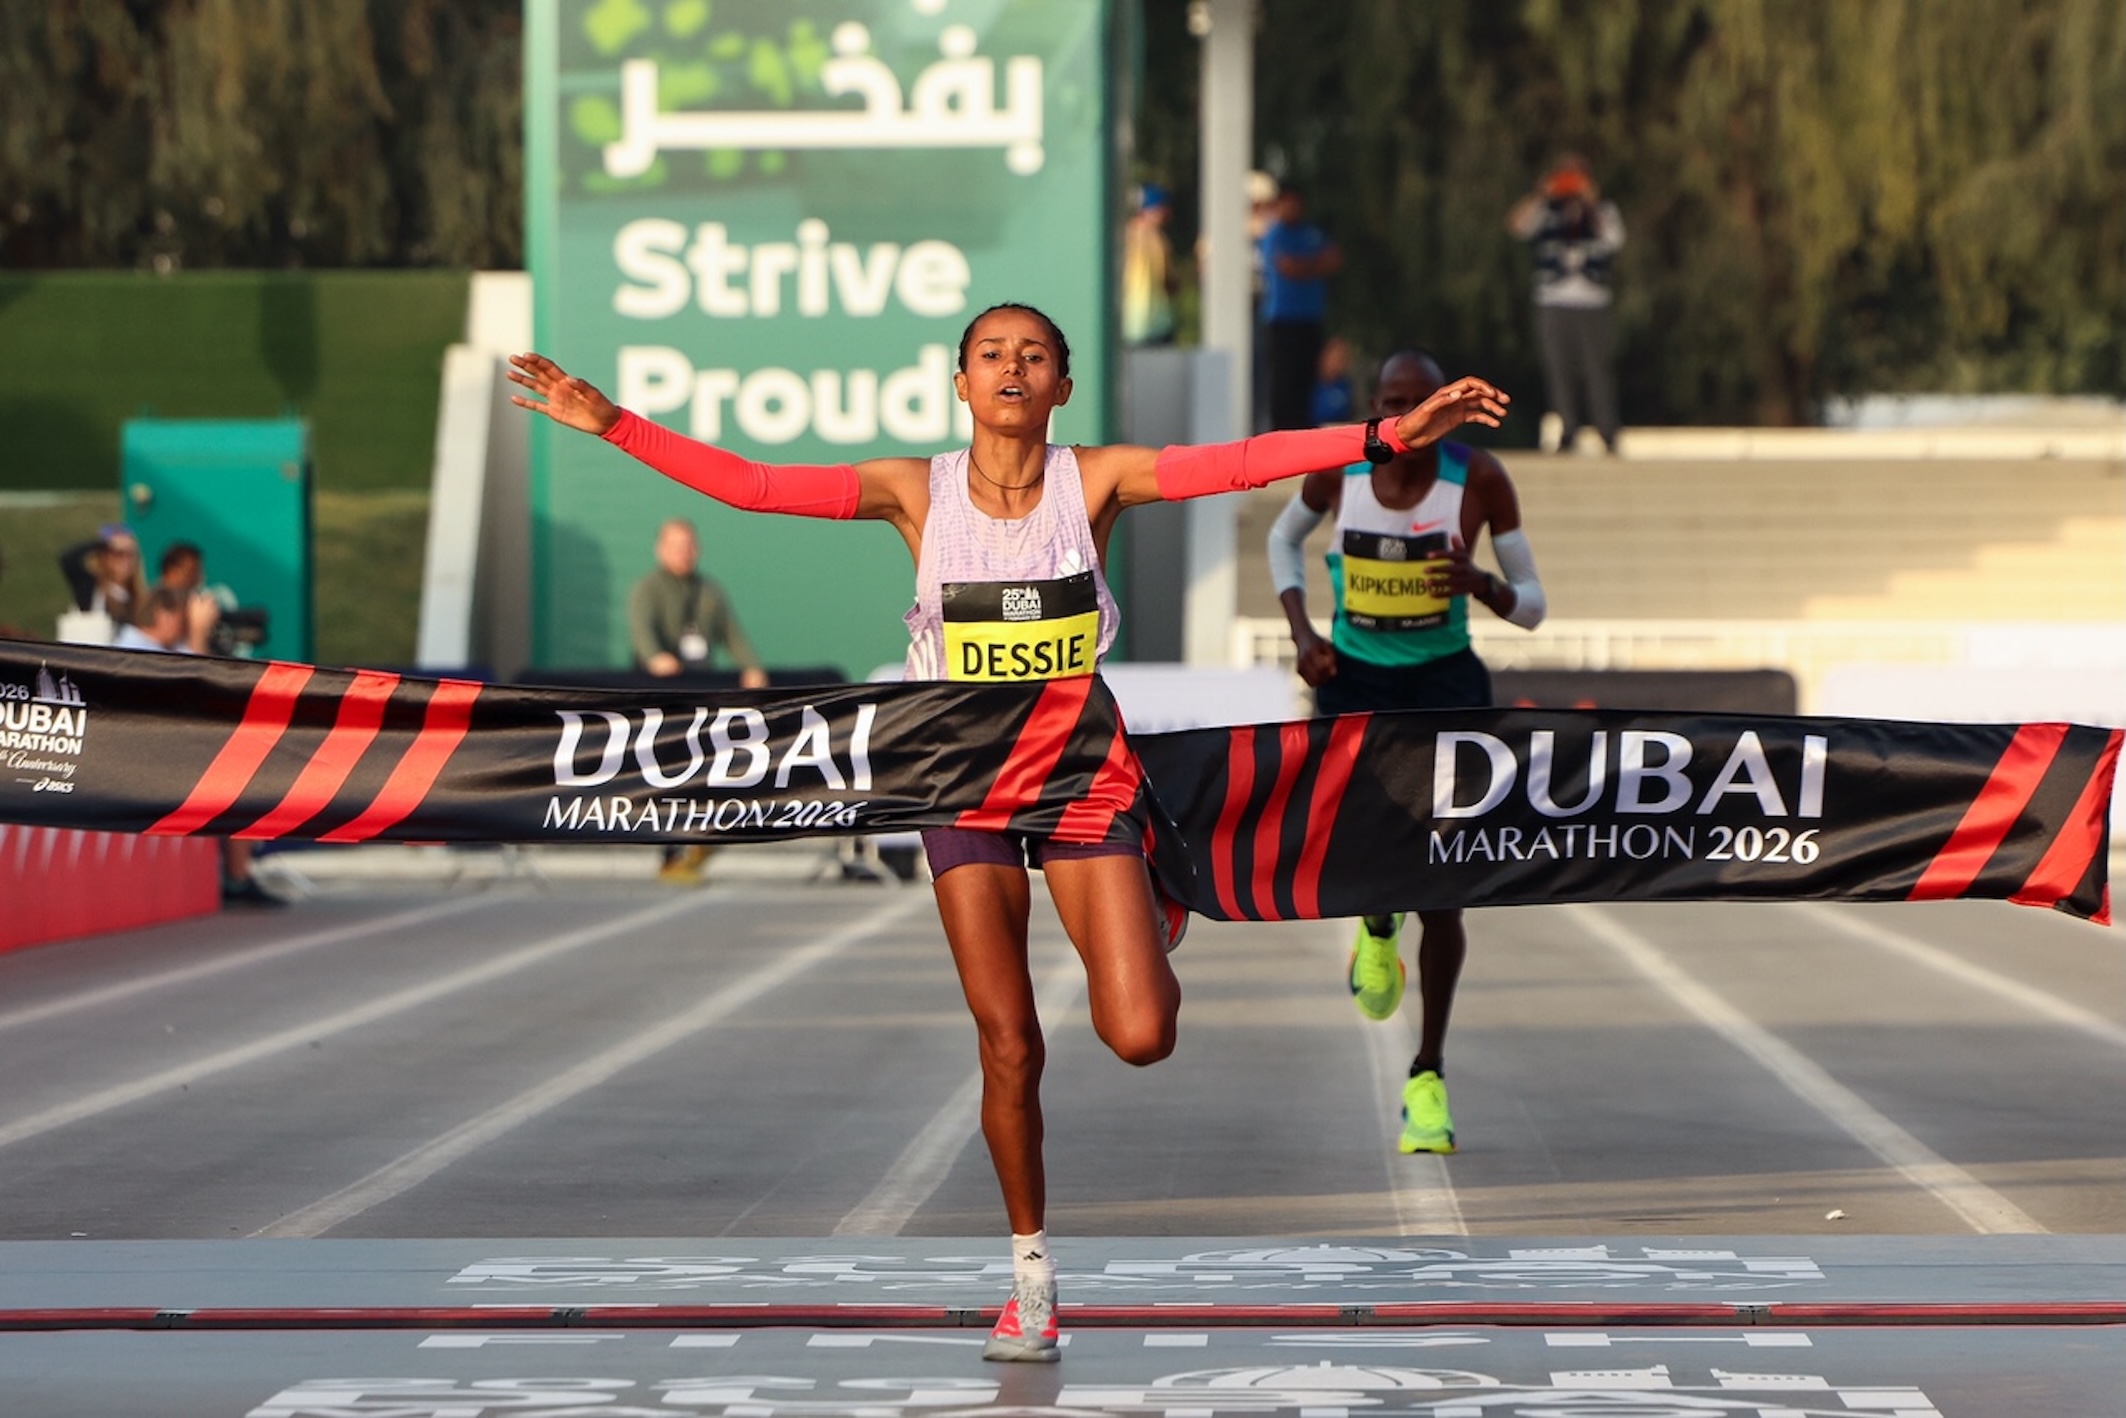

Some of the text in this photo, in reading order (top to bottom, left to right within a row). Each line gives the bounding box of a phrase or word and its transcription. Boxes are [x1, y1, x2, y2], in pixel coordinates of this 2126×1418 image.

[604, 21, 1045, 177] بفخر
[612, 217, 971, 319] Strive
[616, 345, 974, 443] Proud
[1002, 600, 1041, 611] DUBAI
[1350, 574, 1430, 597] KIPKEMB
[962, 634, 1085, 676] DESSIE
[0, 701, 87, 738] UBAI
[0, 730, 83, 756] ARATHON
[553, 703, 877, 791] DUBAI
[1431, 730, 1828, 819] DUBAI
[542, 796, 868, 833] MARATHON 2026
[1428, 824, 1821, 864] MARATHON 2026
